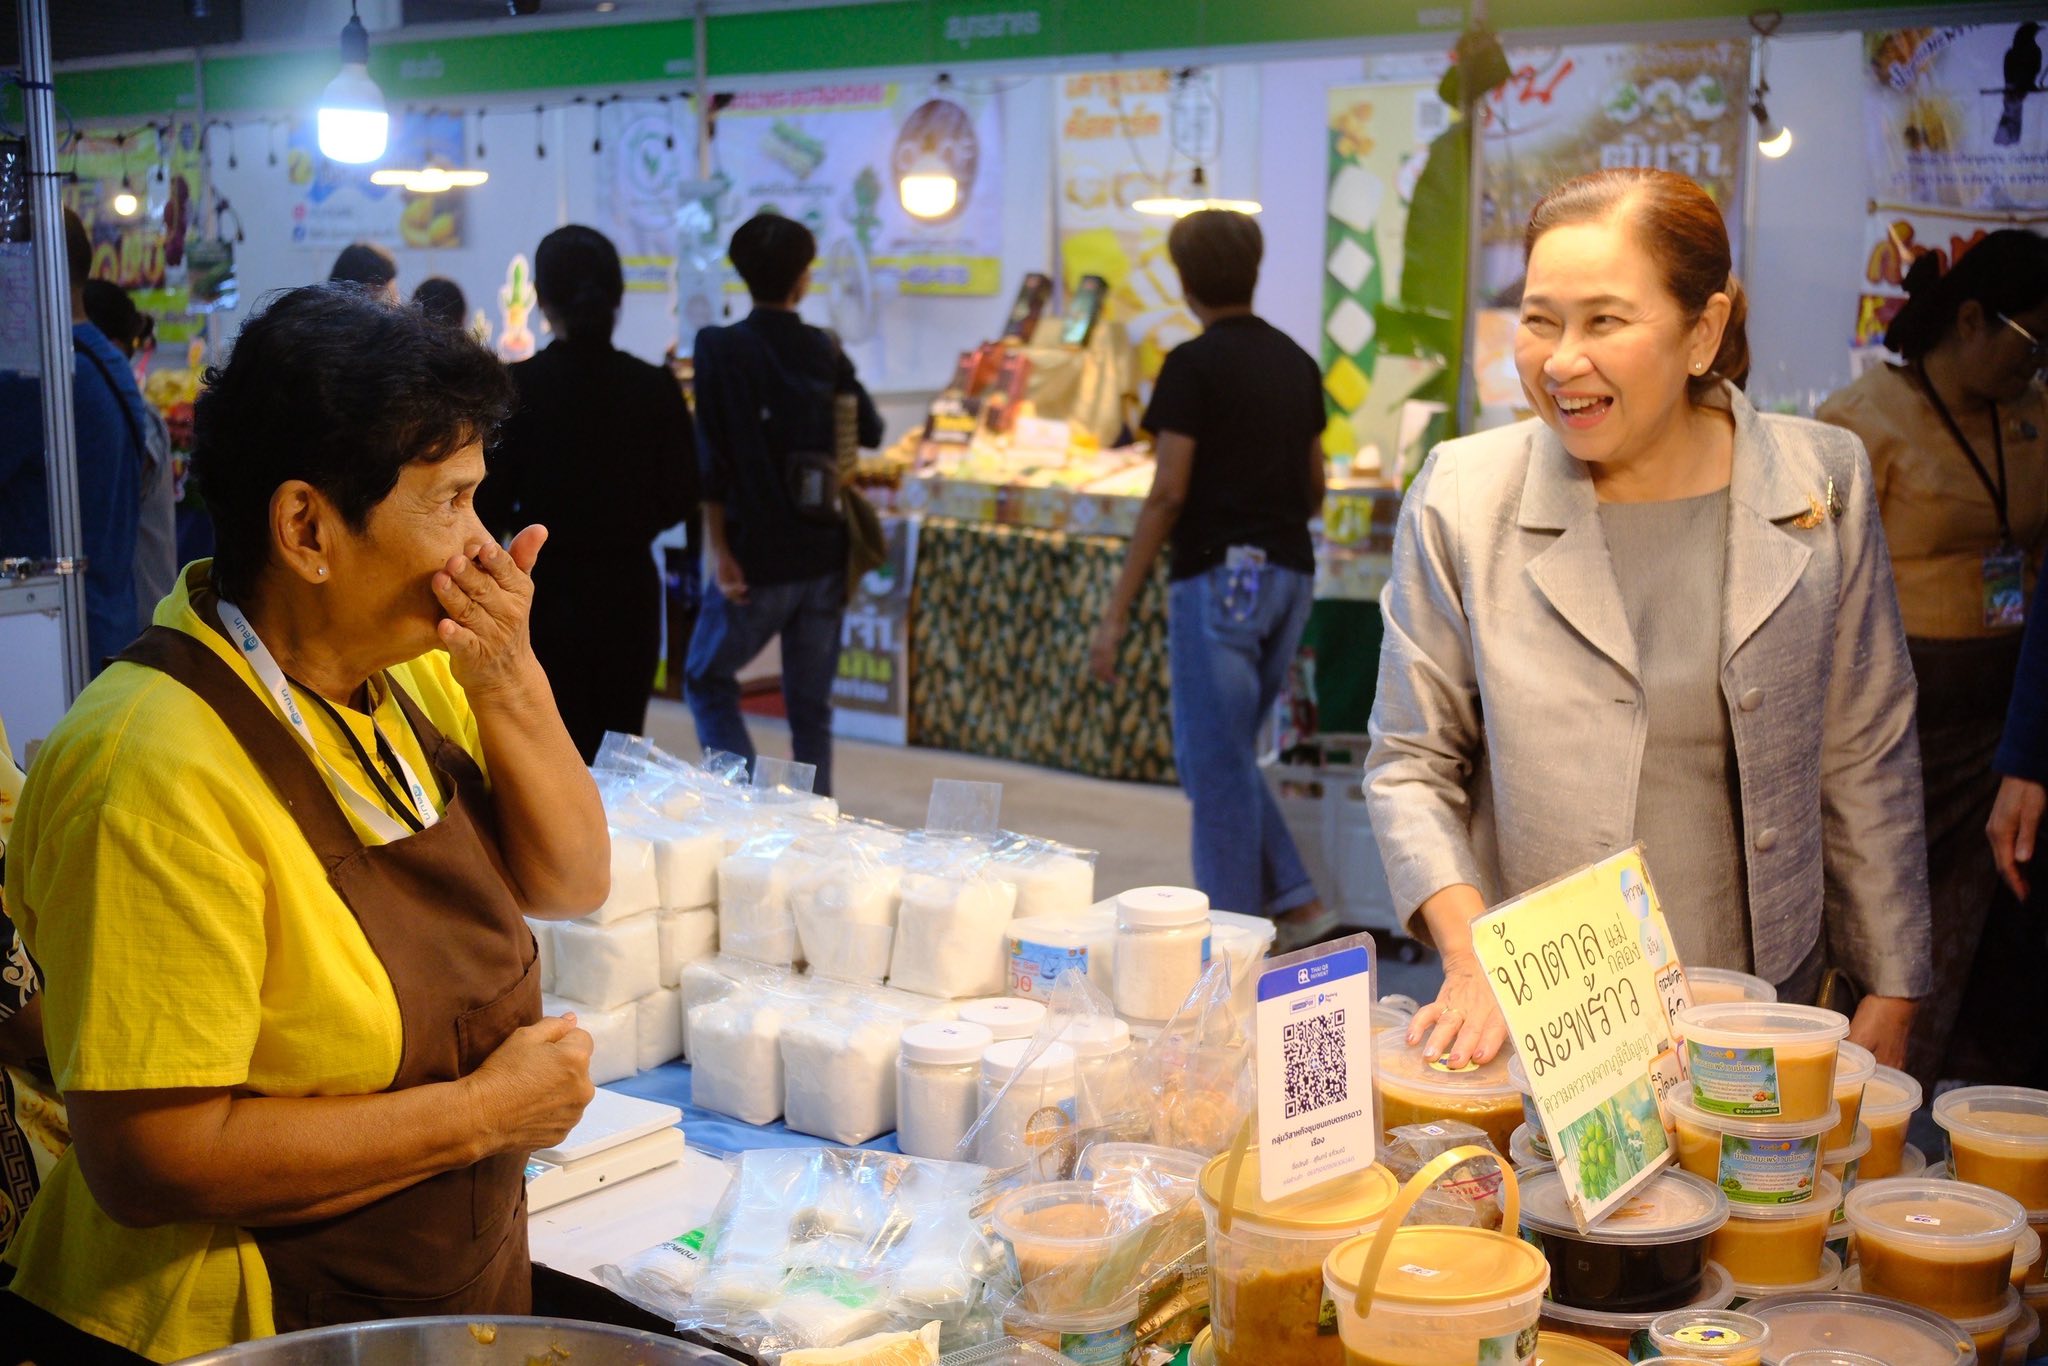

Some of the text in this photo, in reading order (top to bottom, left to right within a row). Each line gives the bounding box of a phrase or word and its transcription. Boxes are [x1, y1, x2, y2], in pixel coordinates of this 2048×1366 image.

[1622, 881, 1646, 904] หวาน
[1604, 913, 1628, 949] แม่
[1310, 970, 1329, 979] PAYMENT
[1493, 922, 1604, 1006] น้ำตาล
[1607, 942, 1641, 975] กลอง
[1525, 973, 1641, 1077] มะพร้าว
[1543, 1033, 1654, 1114] ความหวานจากภูมิปัญญา
[1271, 1109, 1363, 1145] กลุ่มวิสาหกิจชุมชนเกษตรกรดาว
